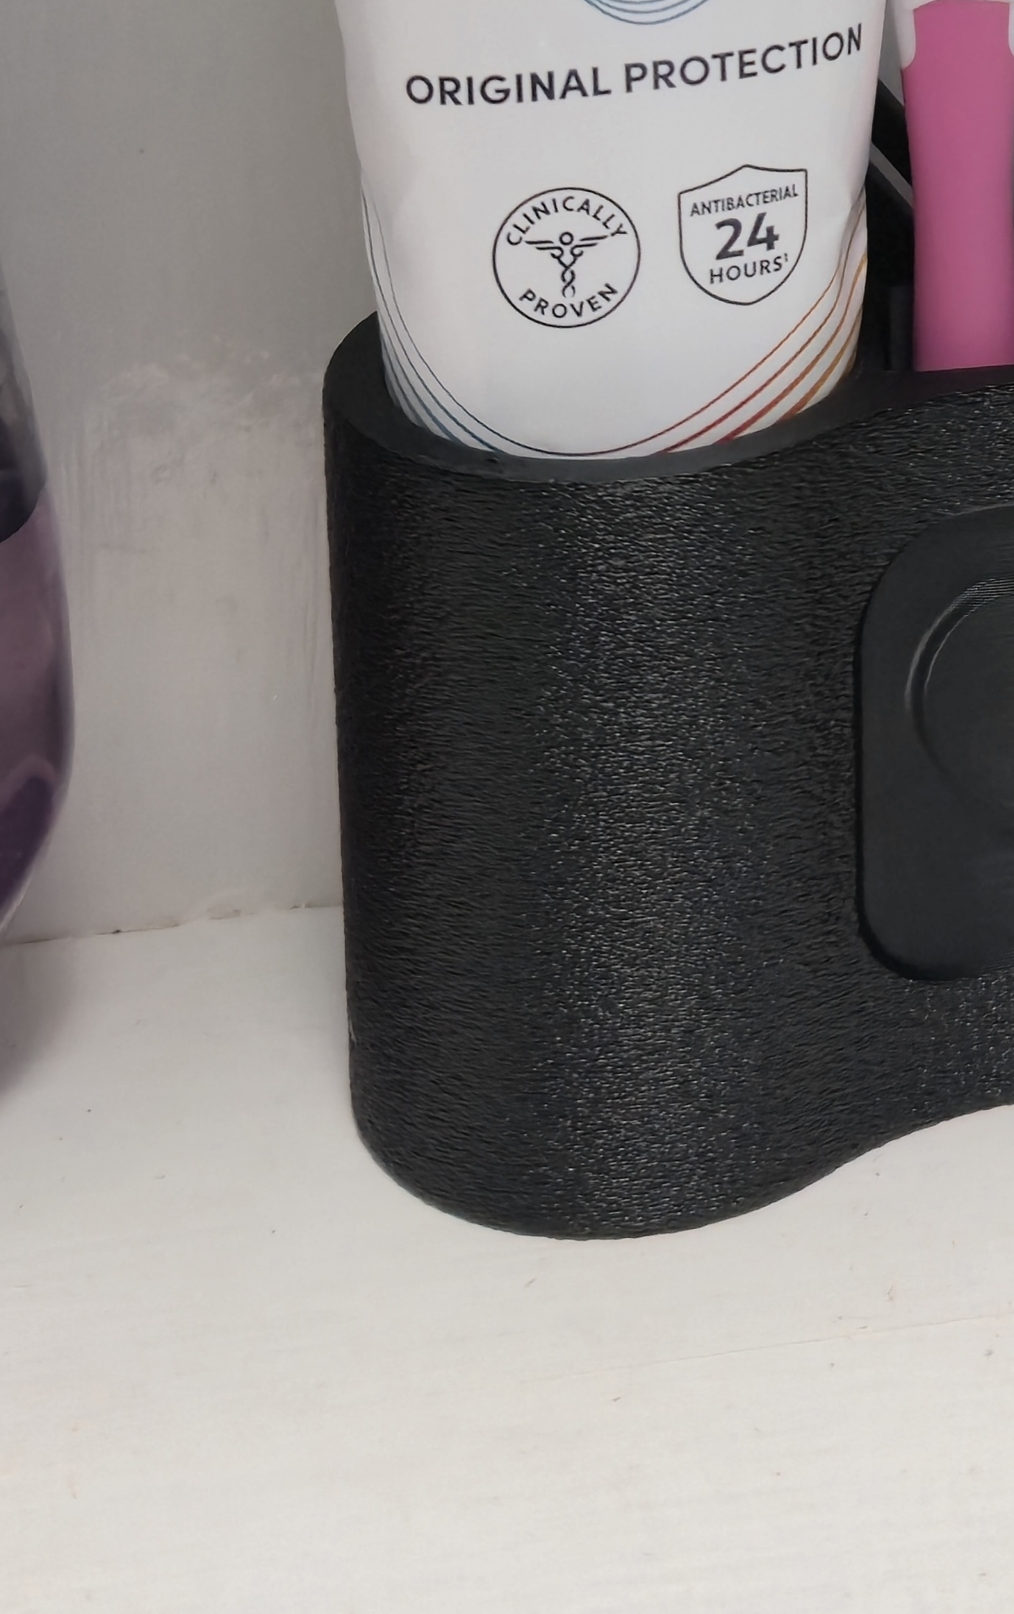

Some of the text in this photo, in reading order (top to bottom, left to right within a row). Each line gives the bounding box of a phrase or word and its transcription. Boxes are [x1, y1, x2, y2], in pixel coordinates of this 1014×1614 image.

[405, 22, 863, 106] ORIGINAL PROTECTION
[506, 195, 628, 246] CLINICALLY
[690, 183, 799, 217] ANTIBACTERIAL
[715, 211, 780, 261] 24
[518, 282, 619, 319] PROVEN
